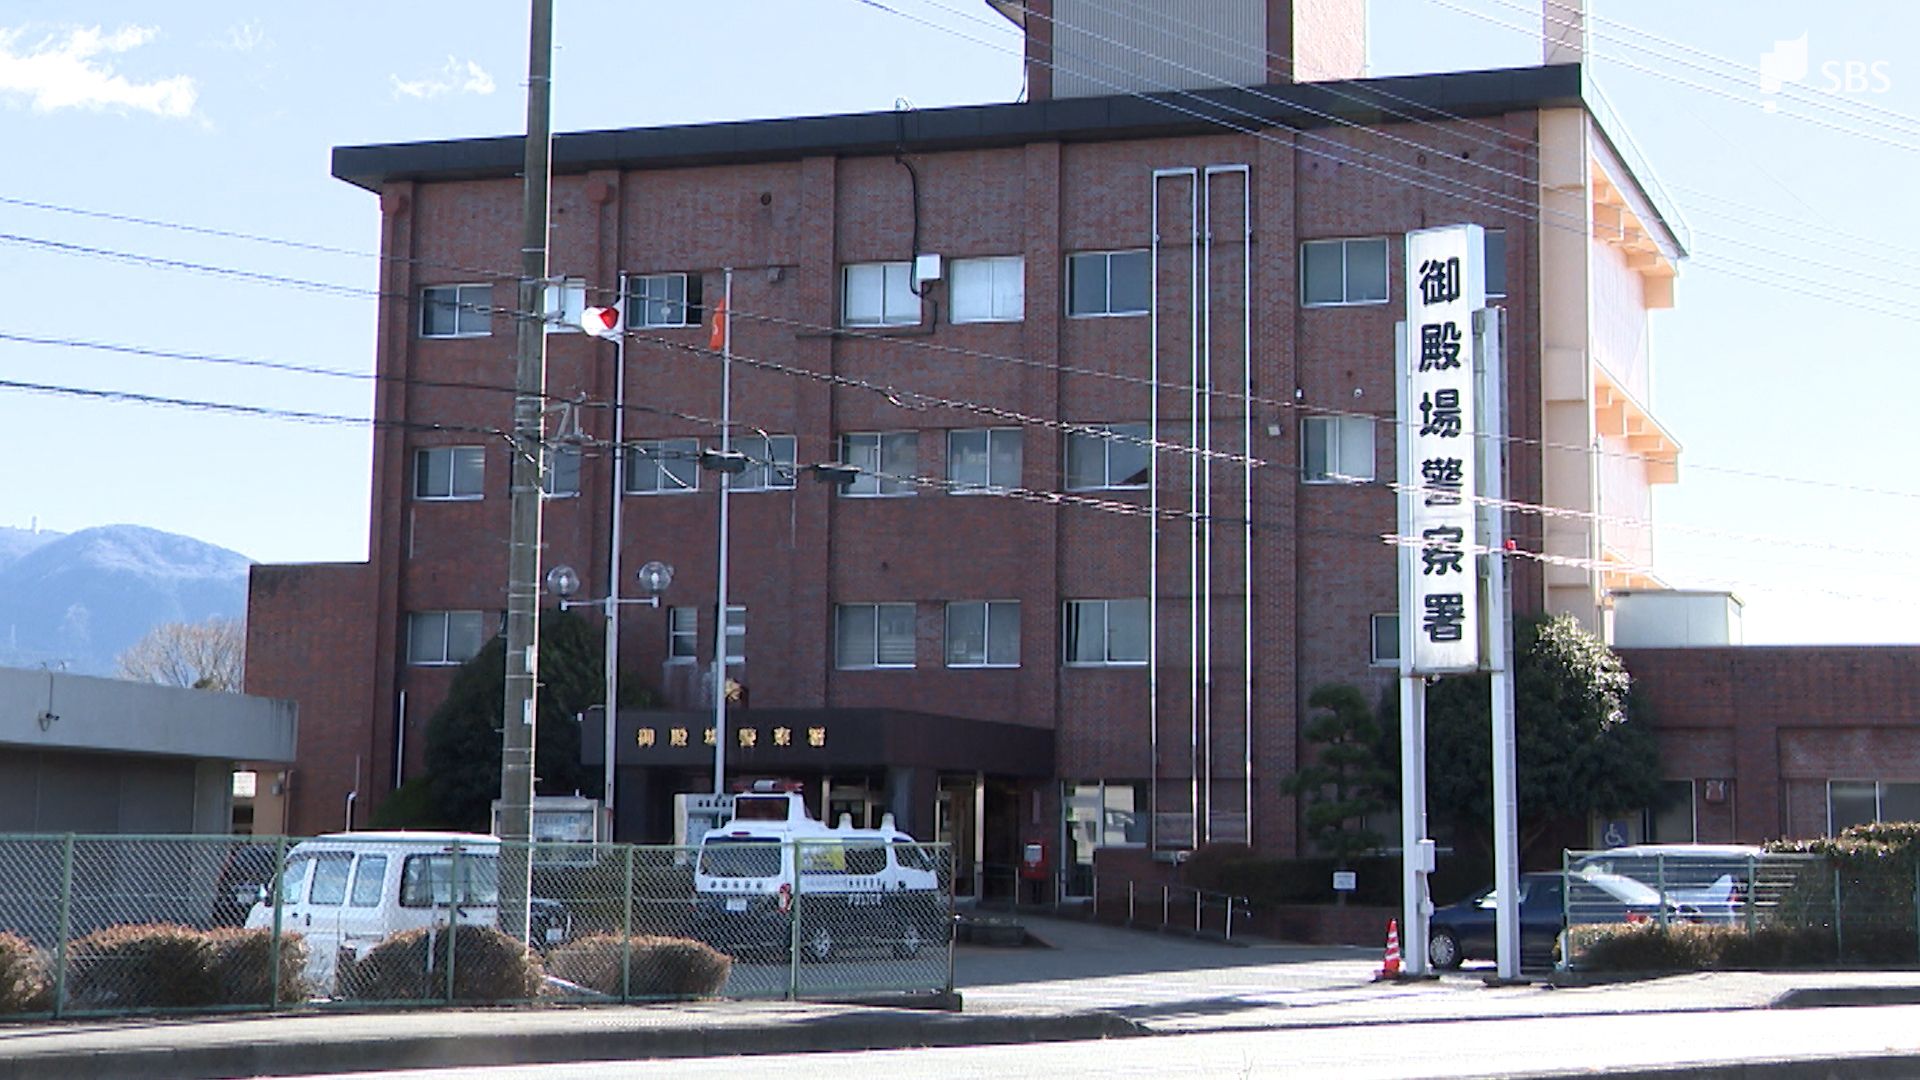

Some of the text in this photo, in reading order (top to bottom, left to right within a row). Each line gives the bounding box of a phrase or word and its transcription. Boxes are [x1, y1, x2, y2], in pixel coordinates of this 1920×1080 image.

[1419, 256, 1465, 643] 御殿場警察署
